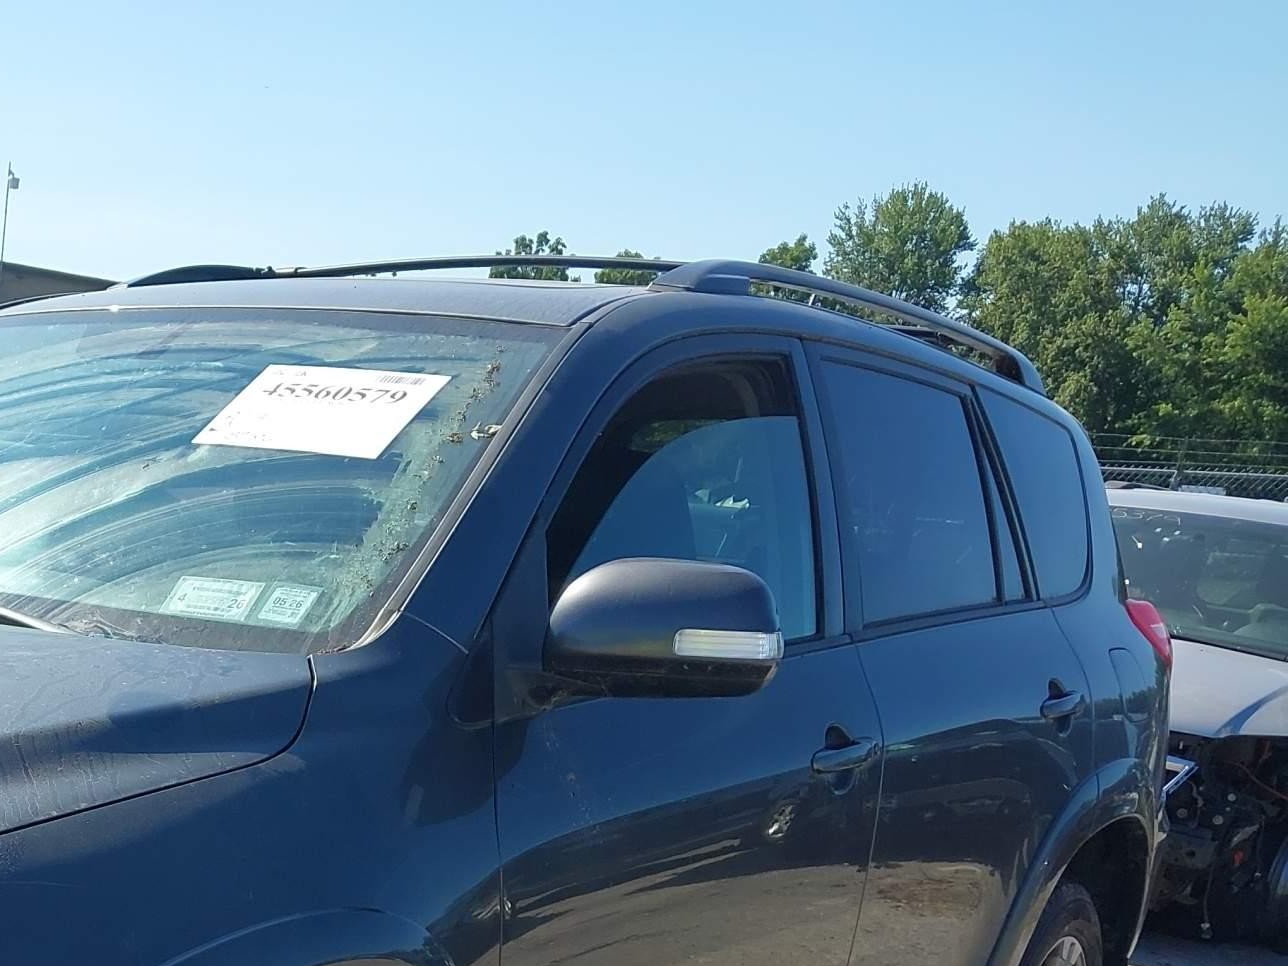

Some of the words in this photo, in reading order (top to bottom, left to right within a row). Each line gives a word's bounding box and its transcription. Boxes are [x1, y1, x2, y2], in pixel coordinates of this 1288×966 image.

[263, 383, 408, 404] 45560579
[273, 597, 288, 606] 05
[289, 600, 304, 608] 26
